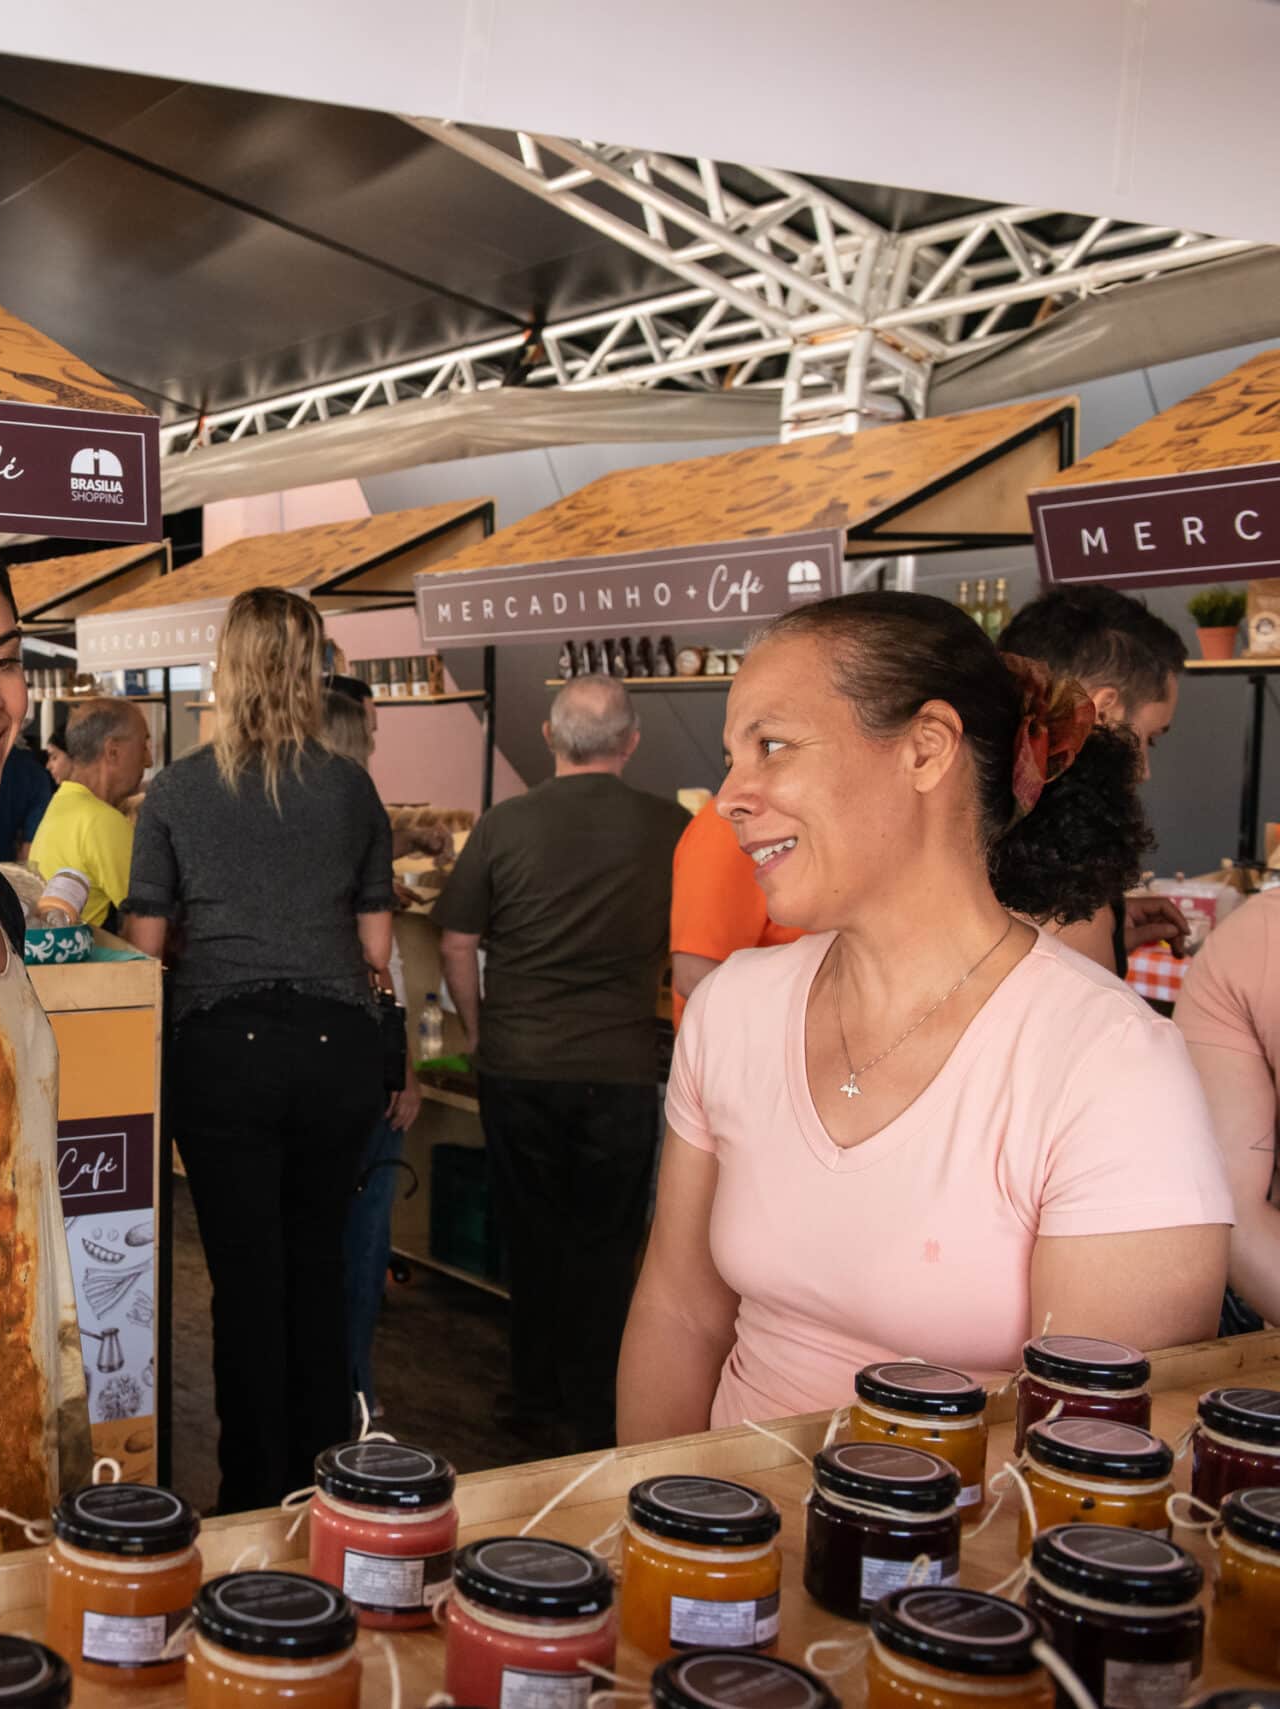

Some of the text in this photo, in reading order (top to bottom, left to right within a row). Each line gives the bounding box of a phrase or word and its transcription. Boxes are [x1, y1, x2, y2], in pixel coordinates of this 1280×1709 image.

[71, 490, 124, 504] SHOPPING
[1080, 509, 1263, 556] MERC
[437, 581, 672, 623] MERCADINHO
[707, 563, 765, 613] Café
[87, 624, 217, 653] MERCADINHO
[57, 1147, 119, 1190] Café
